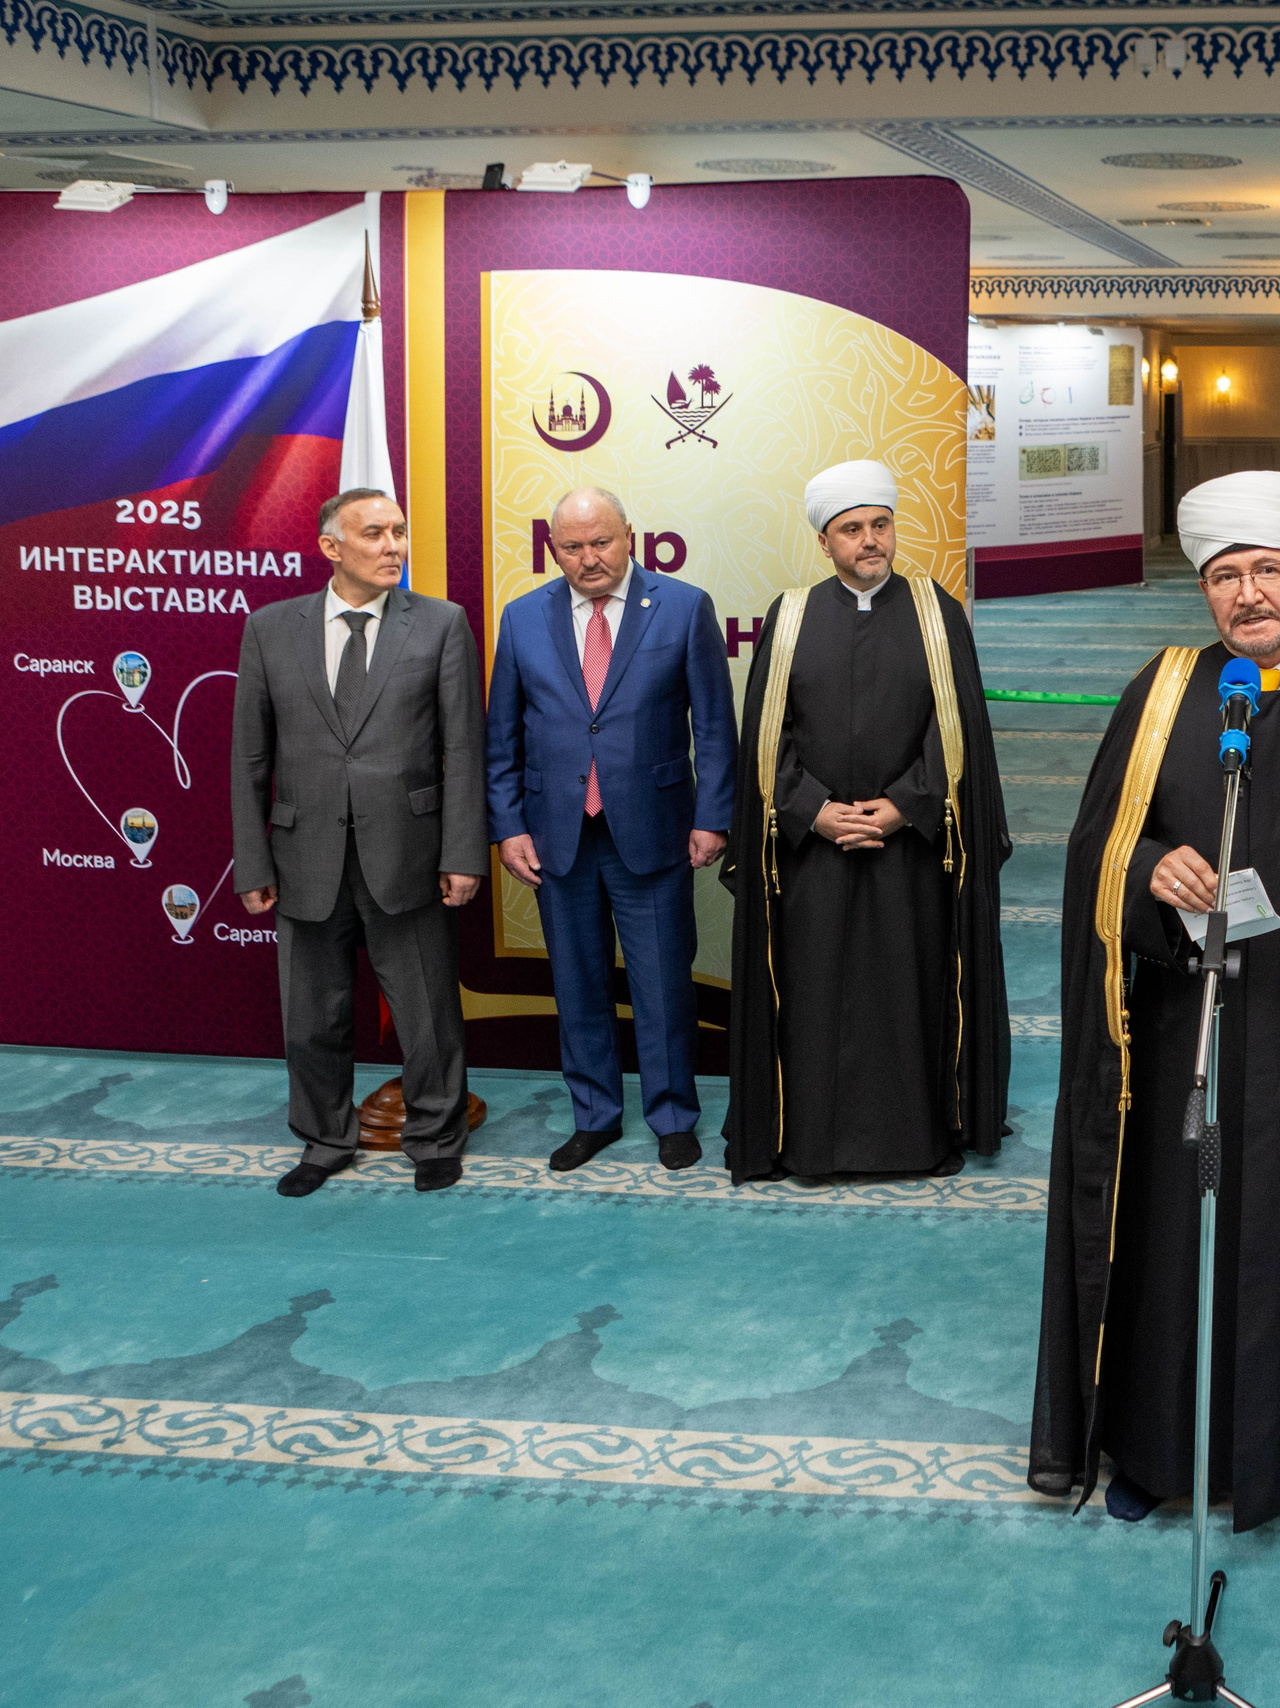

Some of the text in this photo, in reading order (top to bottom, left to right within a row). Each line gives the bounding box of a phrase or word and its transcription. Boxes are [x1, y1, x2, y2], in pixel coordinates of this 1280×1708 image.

[116, 499, 202, 530] 2025
[19, 545, 302, 577] ИНТЕРАКТИВНАЯ
[73, 585, 250, 614] ВЫСТАВКА
[13, 652, 96, 678] Саранск
[42, 847, 115, 869] Москва
